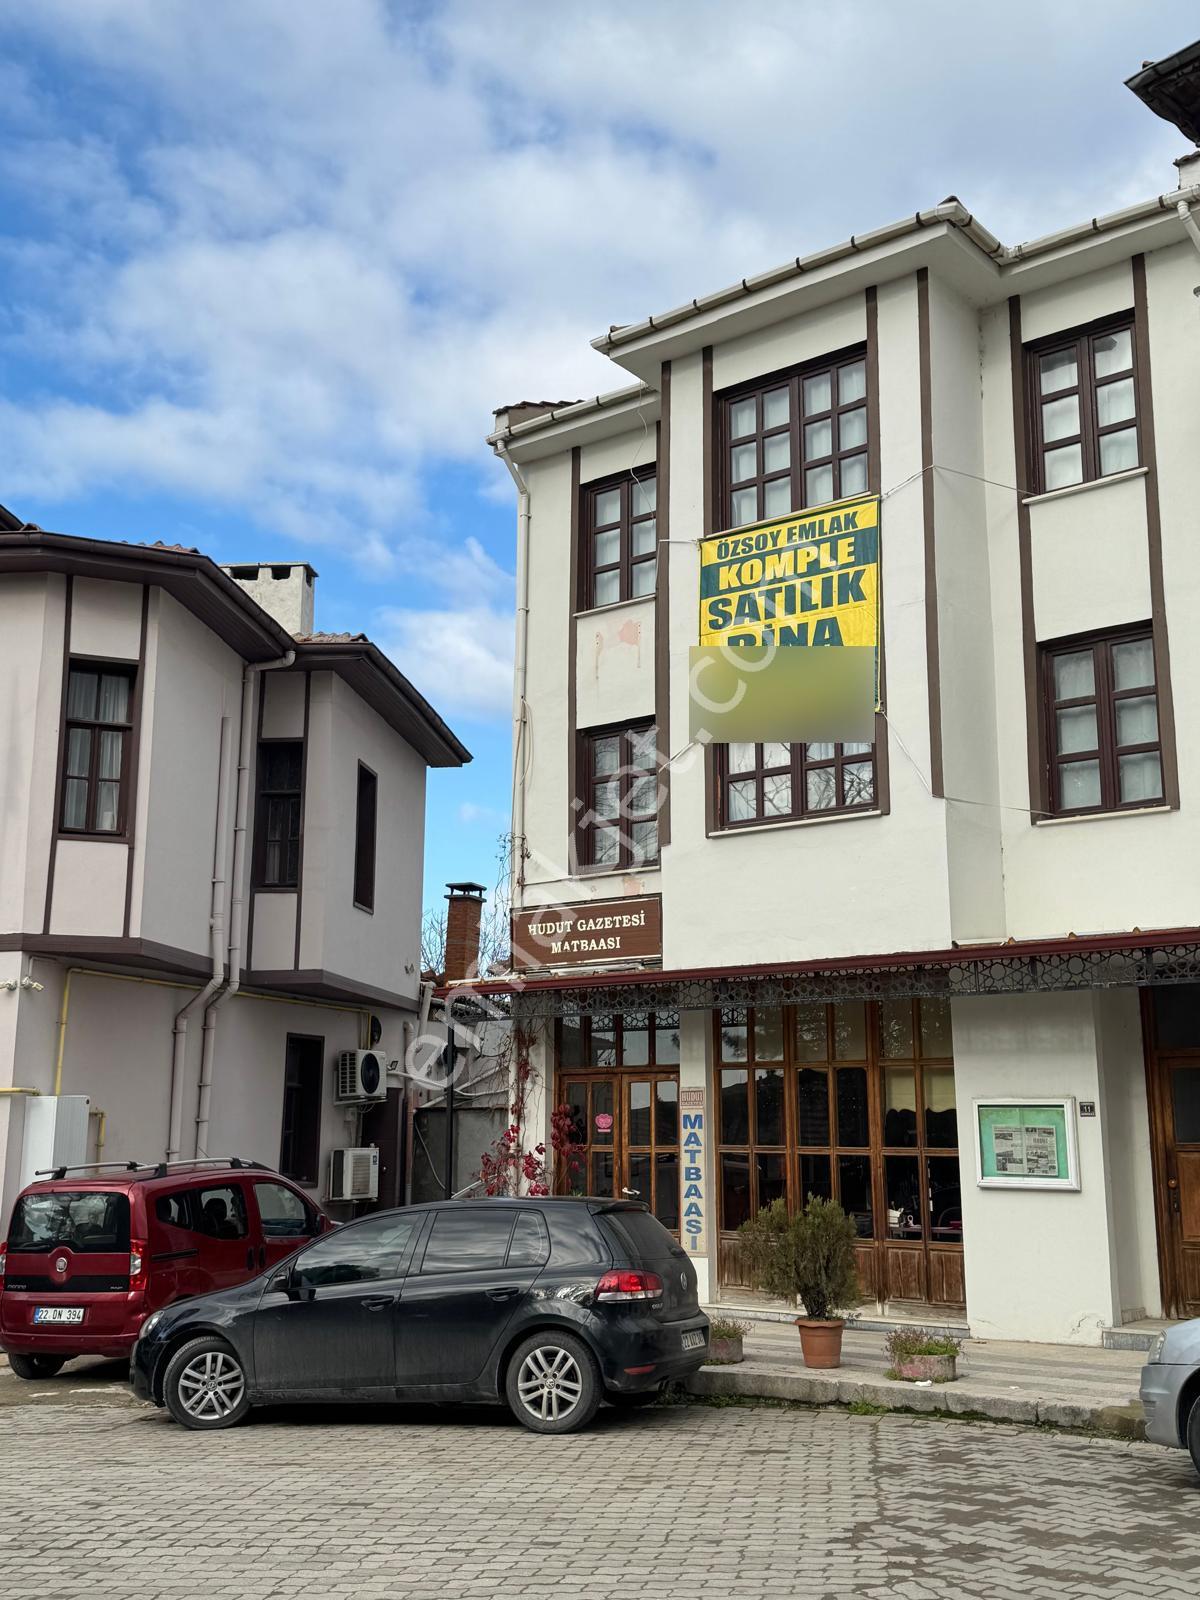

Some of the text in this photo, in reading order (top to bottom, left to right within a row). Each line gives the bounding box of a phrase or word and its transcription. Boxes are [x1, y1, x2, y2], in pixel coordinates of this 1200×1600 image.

[717, 511, 858, 560] ÖZSOY EMLAK
[719, 537, 855, 590] KOMPLE
[708, 568, 867, 631] SATILIK
[528, 910, 645, 936] HUDUT GAZETESİ
[551, 936, 621, 954] MATBAASI
[682, 1114, 703, 1250] MATBAASI
[39, 1309, 48, 1319] 22
[66, 1309, 81, 1320] 394
